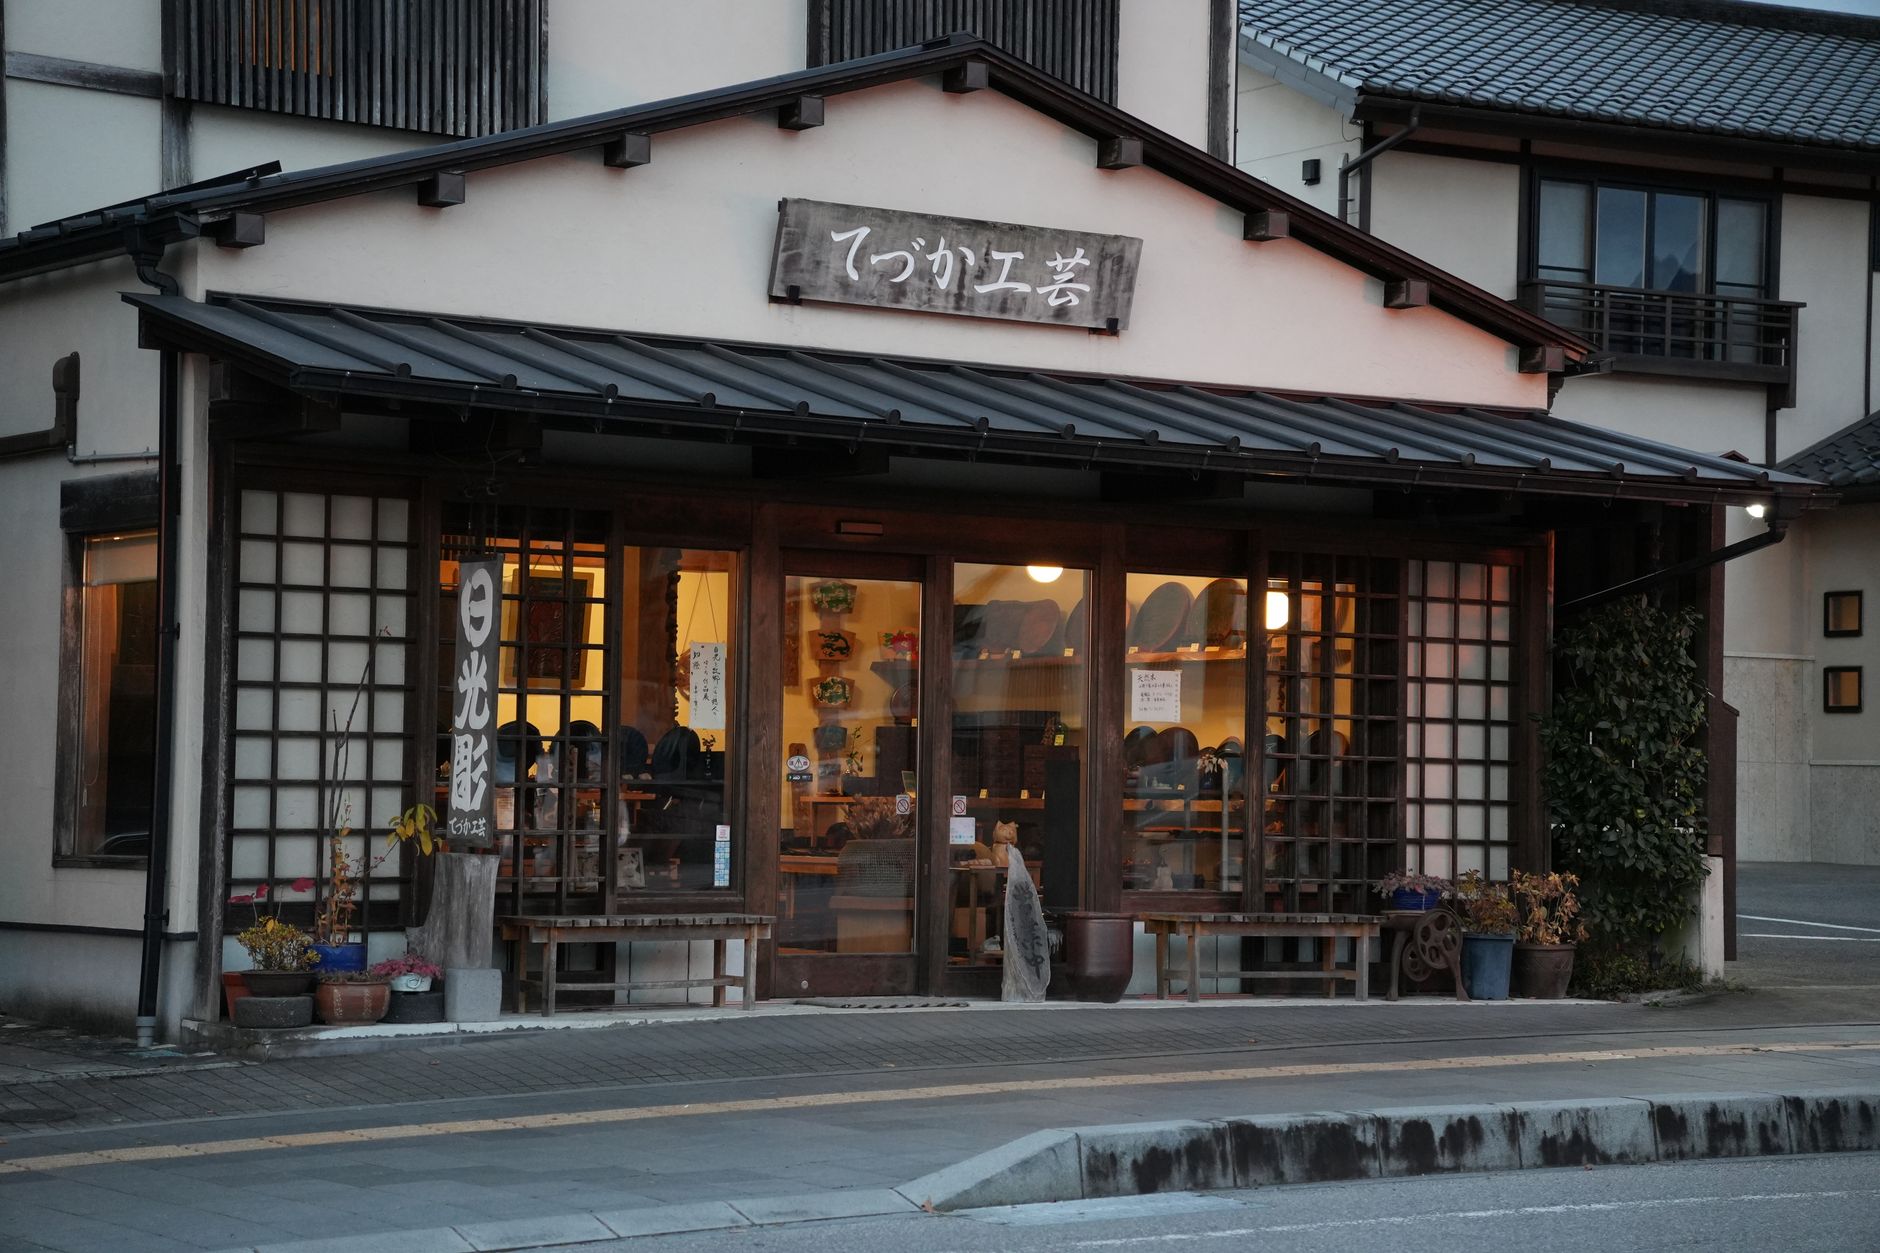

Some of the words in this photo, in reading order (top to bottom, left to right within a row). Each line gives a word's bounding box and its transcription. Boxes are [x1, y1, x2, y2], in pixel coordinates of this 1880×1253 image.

[830, 225, 1091, 307] てづか工芸
[451, 567, 494, 812] 日光彫
[448, 816, 487, 837] てづか工芸
